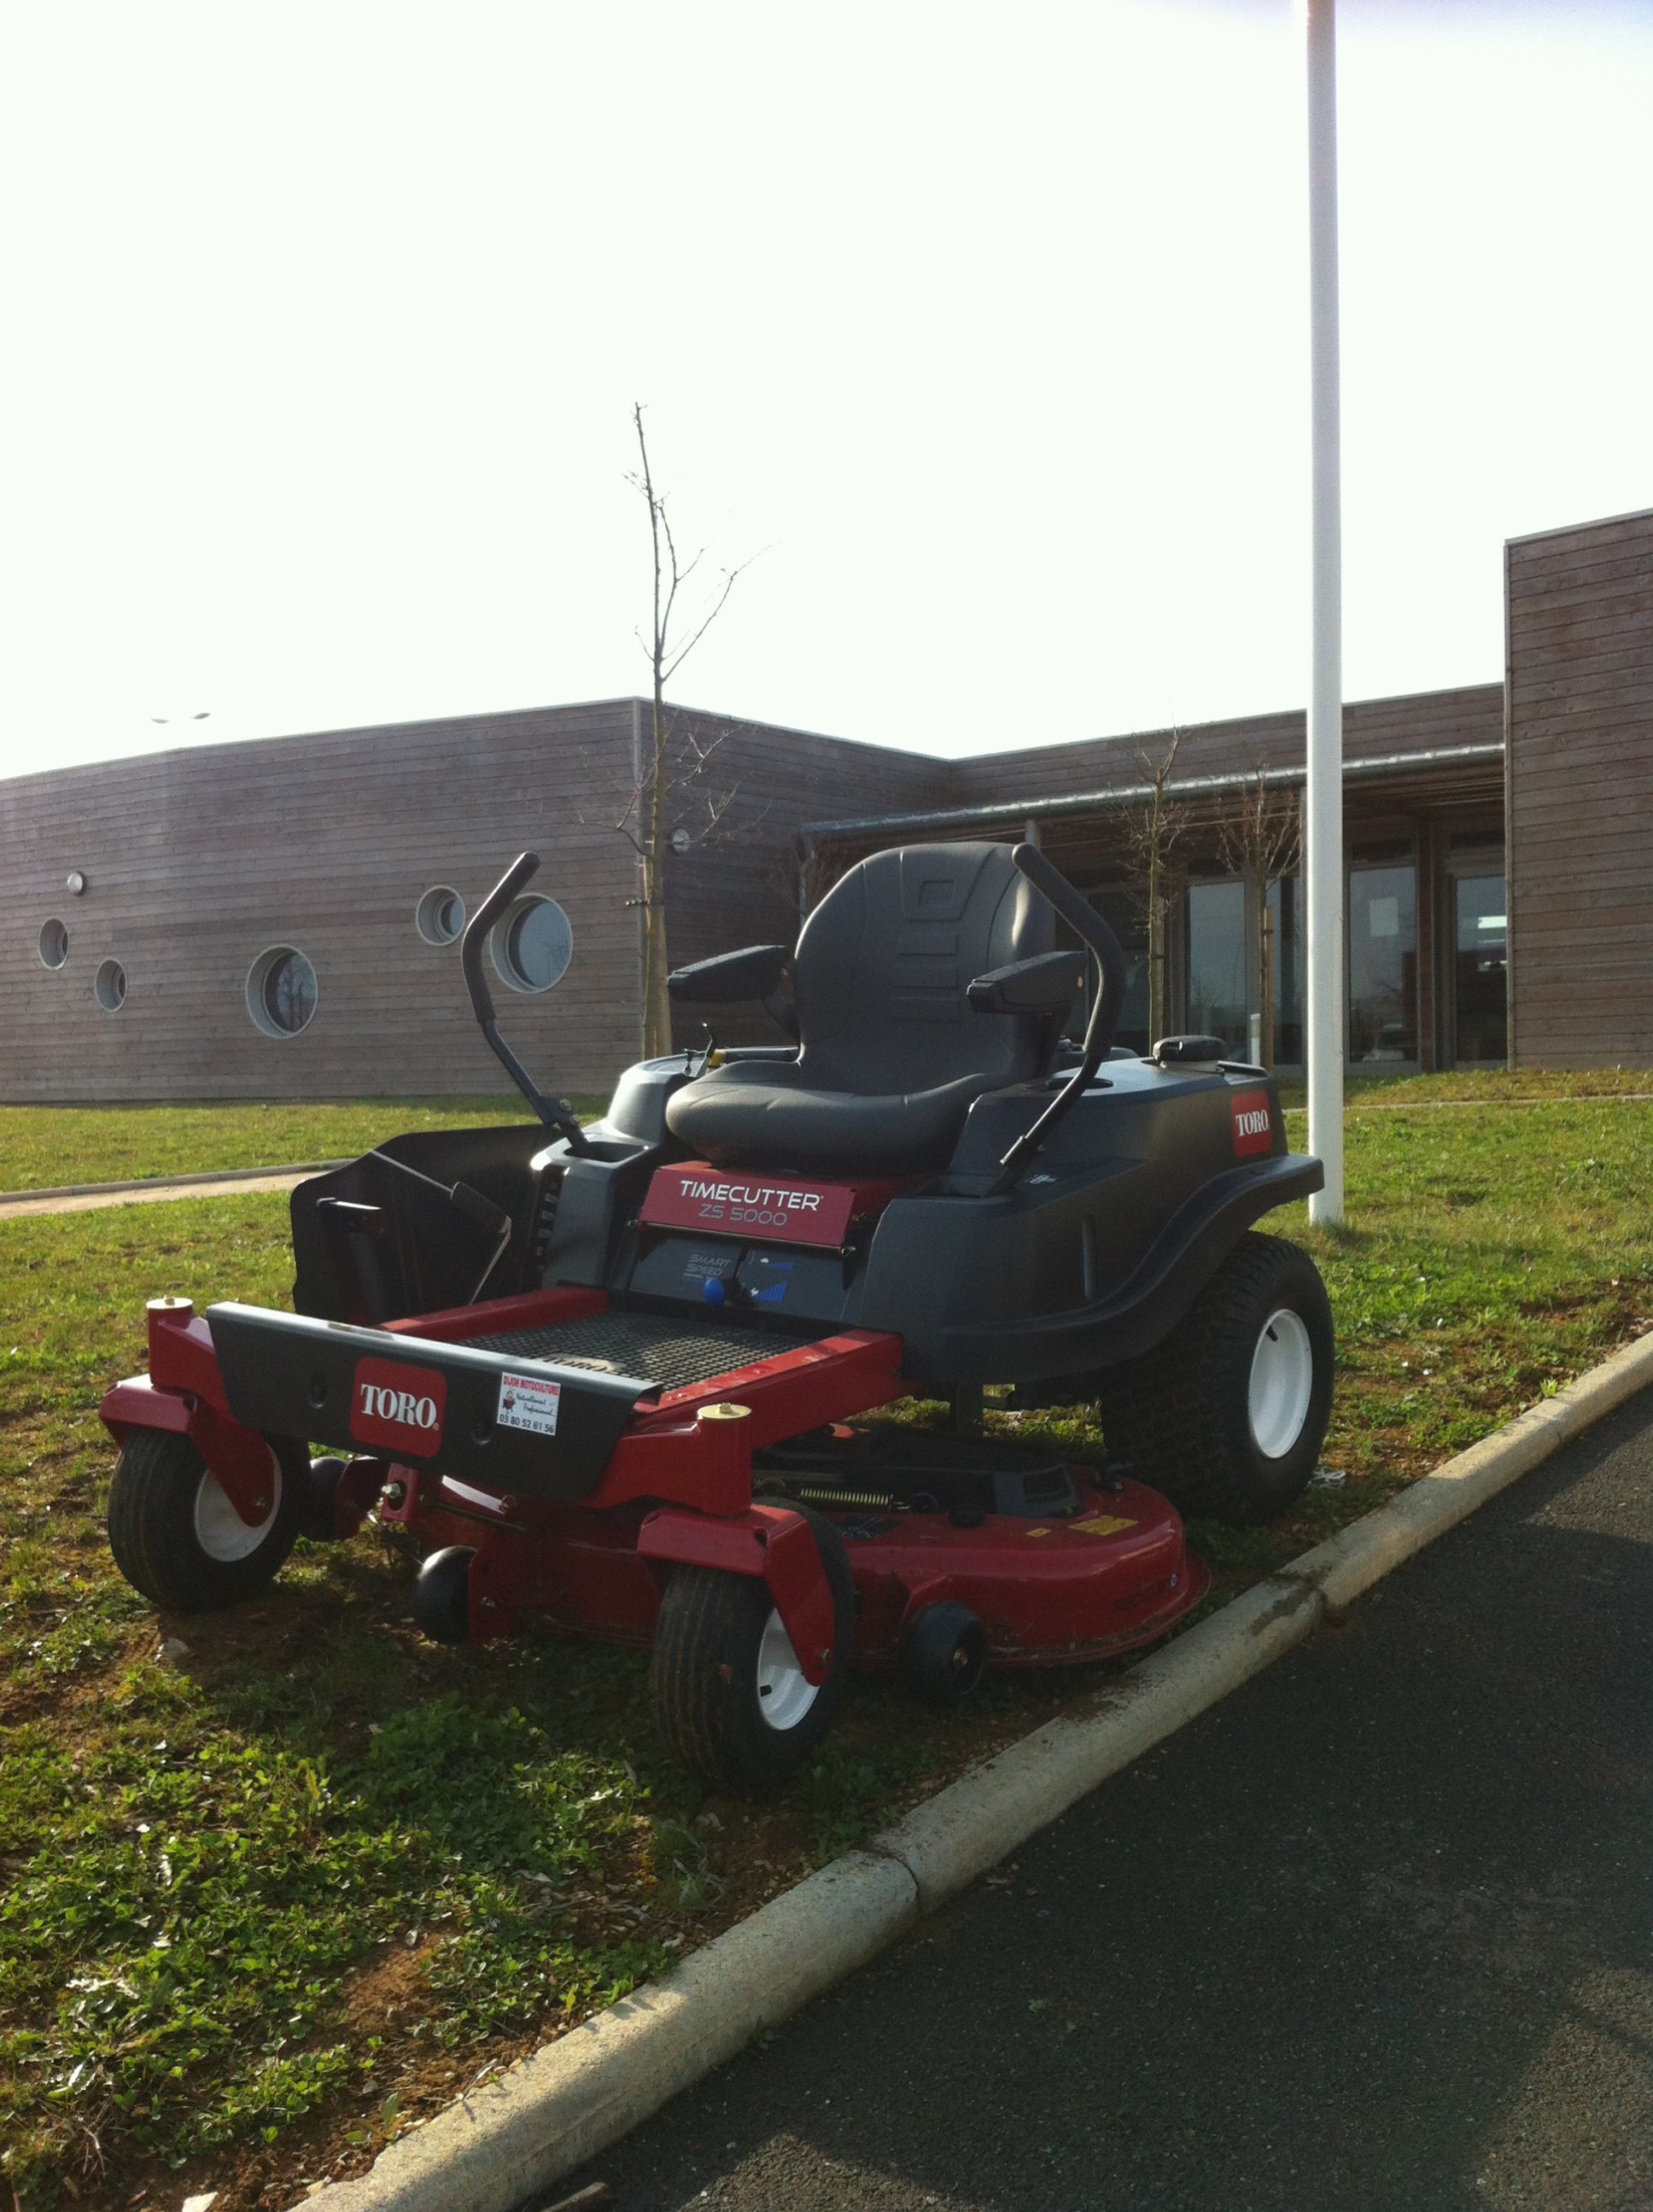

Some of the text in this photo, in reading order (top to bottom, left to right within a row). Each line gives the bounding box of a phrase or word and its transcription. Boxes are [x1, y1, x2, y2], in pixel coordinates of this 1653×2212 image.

[1235, 1109, 1269, 1137] TORO
[680, 1180, 820, 1211] TIMECUTTER
[698, 1203, 787, 1227] ZS 5000
[686, 1264, 722, 1275] SPEED
[689, 1254, 731, 1267] SMART
[360, 1383, 437, 1428] TORO
[499, 1414, 554, 1433] 03 80 52 61 56
